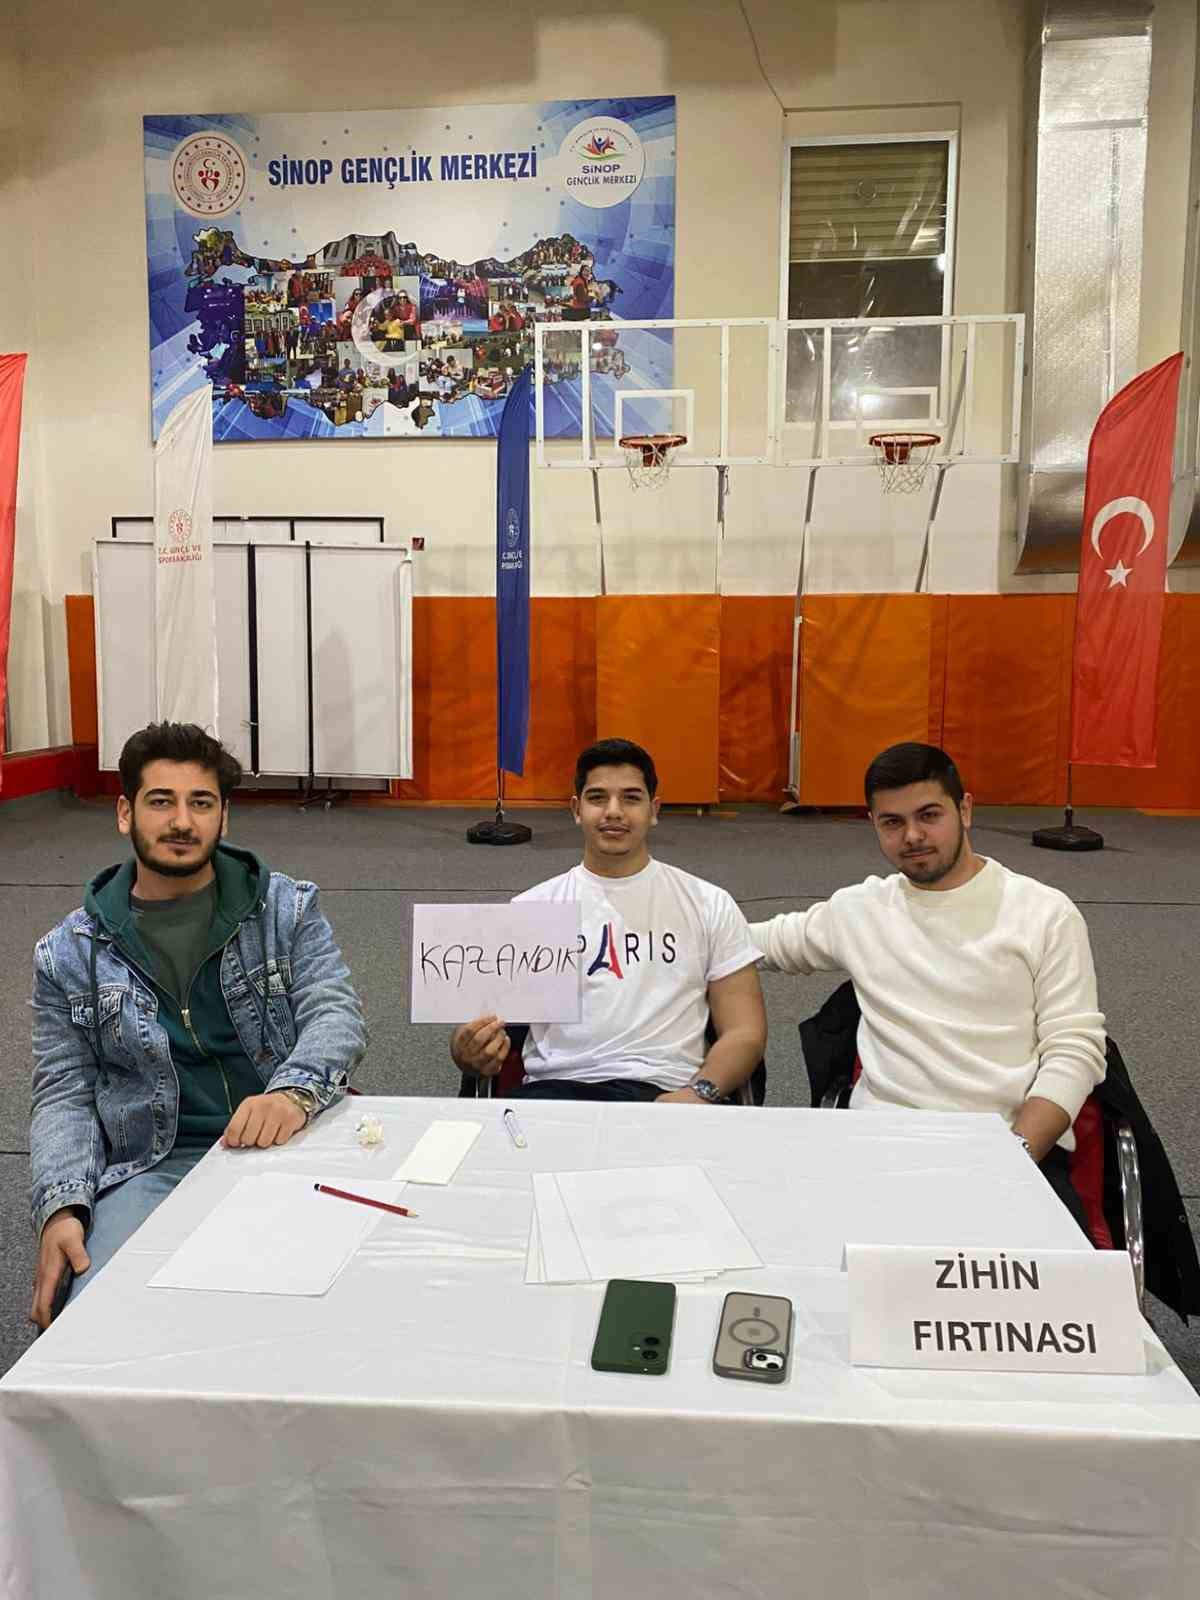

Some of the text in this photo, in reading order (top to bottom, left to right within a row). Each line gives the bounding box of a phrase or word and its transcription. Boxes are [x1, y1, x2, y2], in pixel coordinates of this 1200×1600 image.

[268, 154, 333, 186] SİNOP
[341, 150, 433, 190] GENÇLİK
[440, 145, 538, 181] MERKEZİ
[420, 942, 578, 987] KAZANDIK
[935, 1252, 1040, 1290] ZİHİN
[913, 1320, 1097, 1354] FIRTINASI
